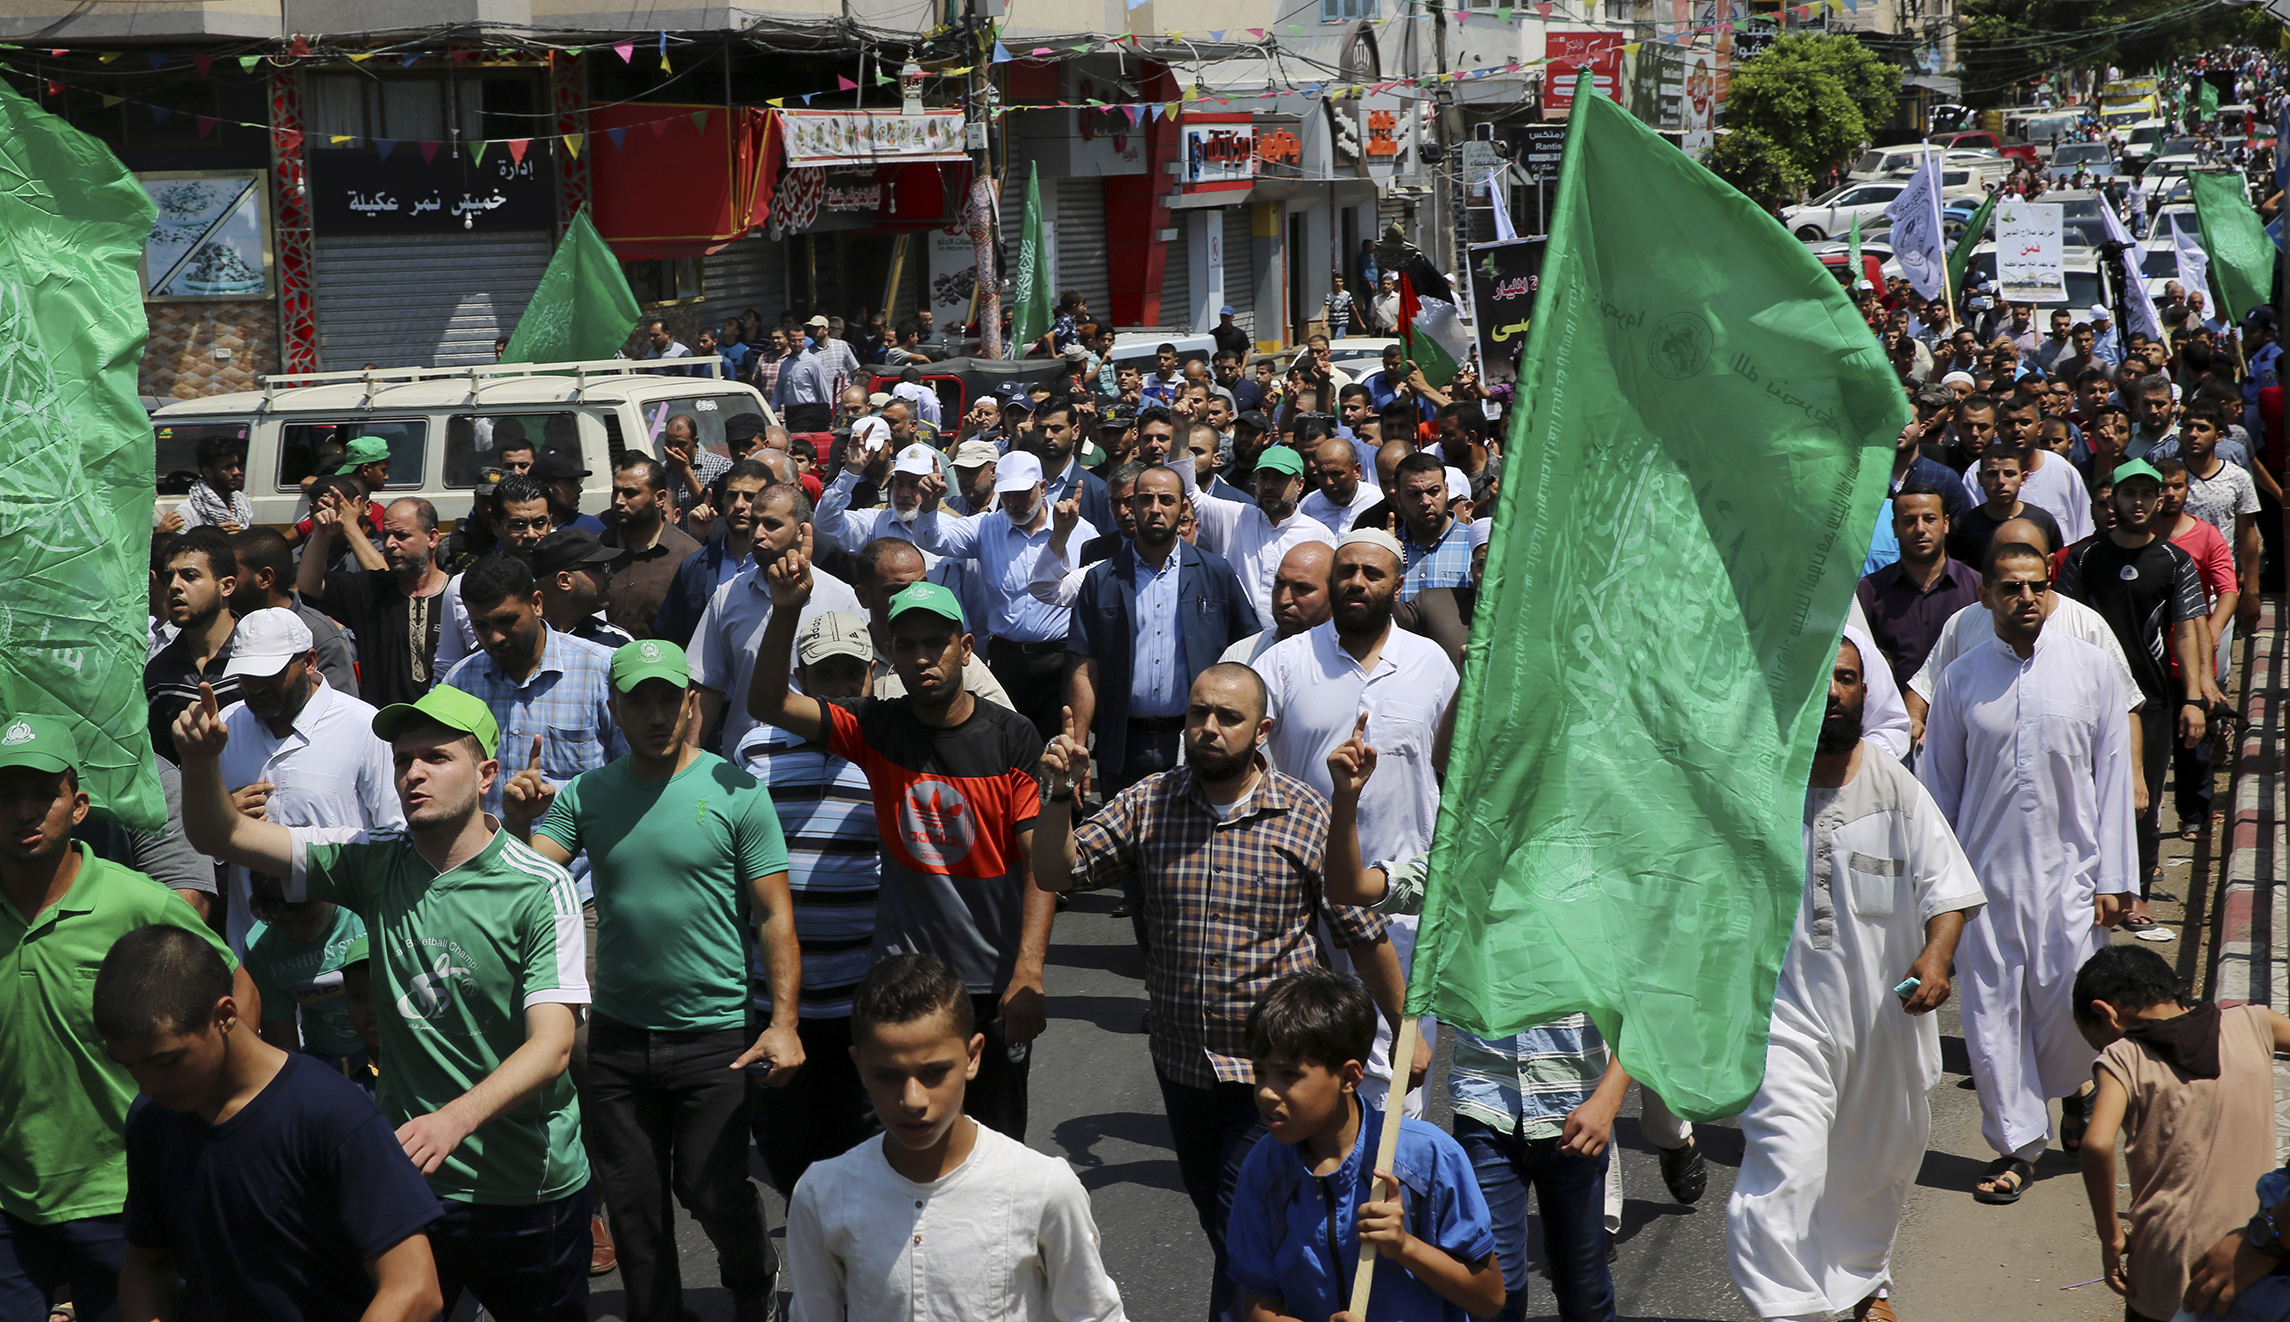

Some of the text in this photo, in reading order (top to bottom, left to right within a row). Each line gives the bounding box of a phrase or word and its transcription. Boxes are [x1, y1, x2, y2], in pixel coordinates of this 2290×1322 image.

[498, 160, 533, 180] إدارة
[347, 188, 507, 217] خميس نمر عكيلة
[2020, 241, 2041, 256] فمن
[907, 830, 963, 849] adidas
[270, 945, 336, 978] FASHION
